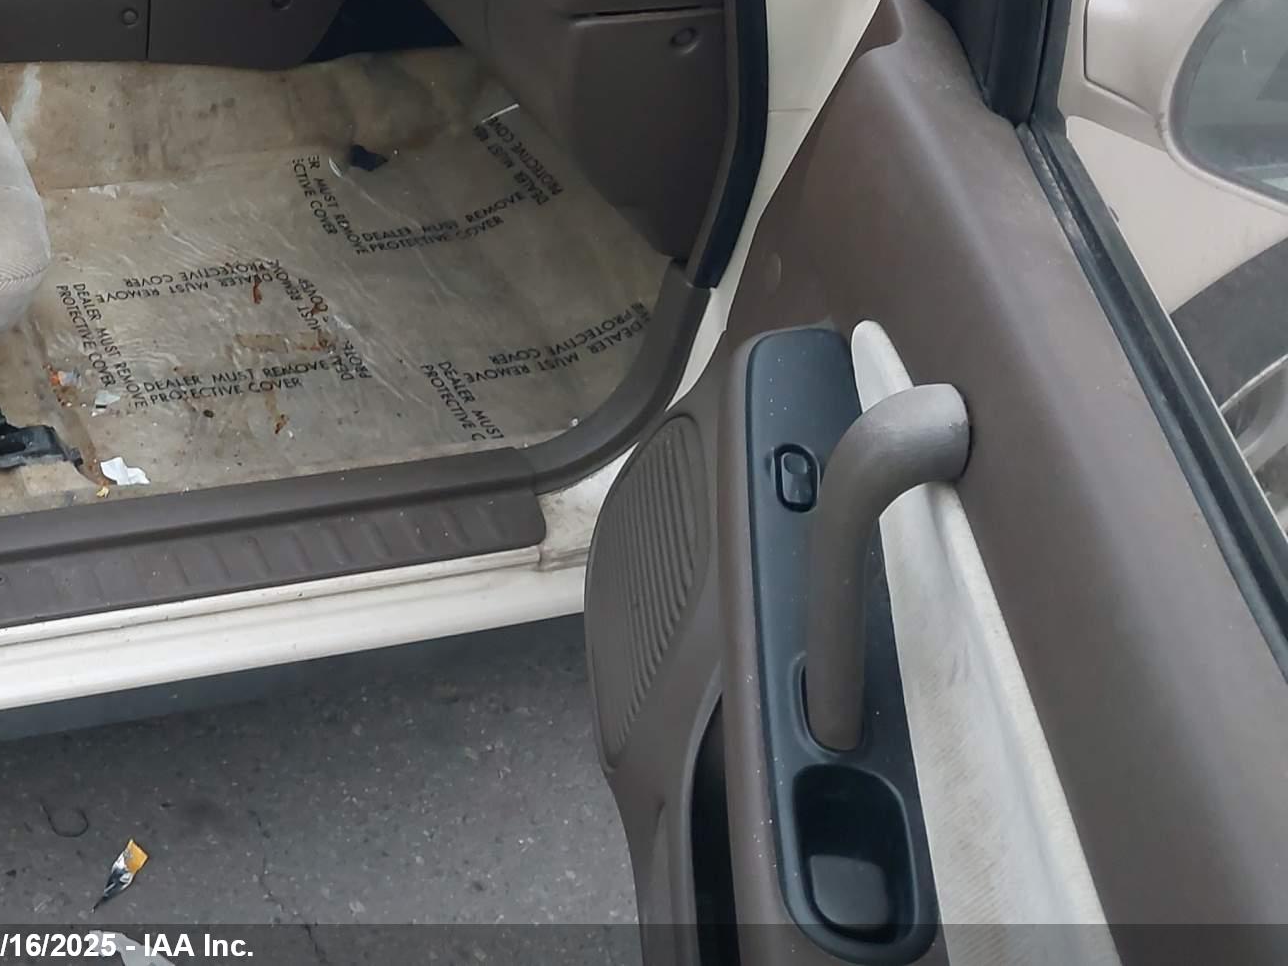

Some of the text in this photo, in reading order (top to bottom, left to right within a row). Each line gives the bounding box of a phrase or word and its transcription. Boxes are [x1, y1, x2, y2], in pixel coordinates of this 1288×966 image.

[313, 178, 339, 208] MUST
[465, 191, 525, 224] REMOVE
[310, 201, 338, 235] COVER
[370, 214, 504, 253] PROTECTIVE COVER
[96, 271, 273, 305] DEALER MUST REMOVE
[122, 274, 174, 289] COVER
[56, 284, 116, 387] PROTECTIVE COVER
[73, 283, 148, 409] DEALER MUST REMOVE
[546, 310, 634, 356] PROTECTIVE
[463, 321, 644, 384] DEALER MUST REMOVE
[489, 348, 542, 366] COVER
[143, 359, 330, 393] DEALER MUST REMOVE
[146, 377, 305, 406] PROTECTIVE COVER
[420, 364, 476, 429] PROTECTIVE
[438, 361, 504, 439] DEALER MUST
